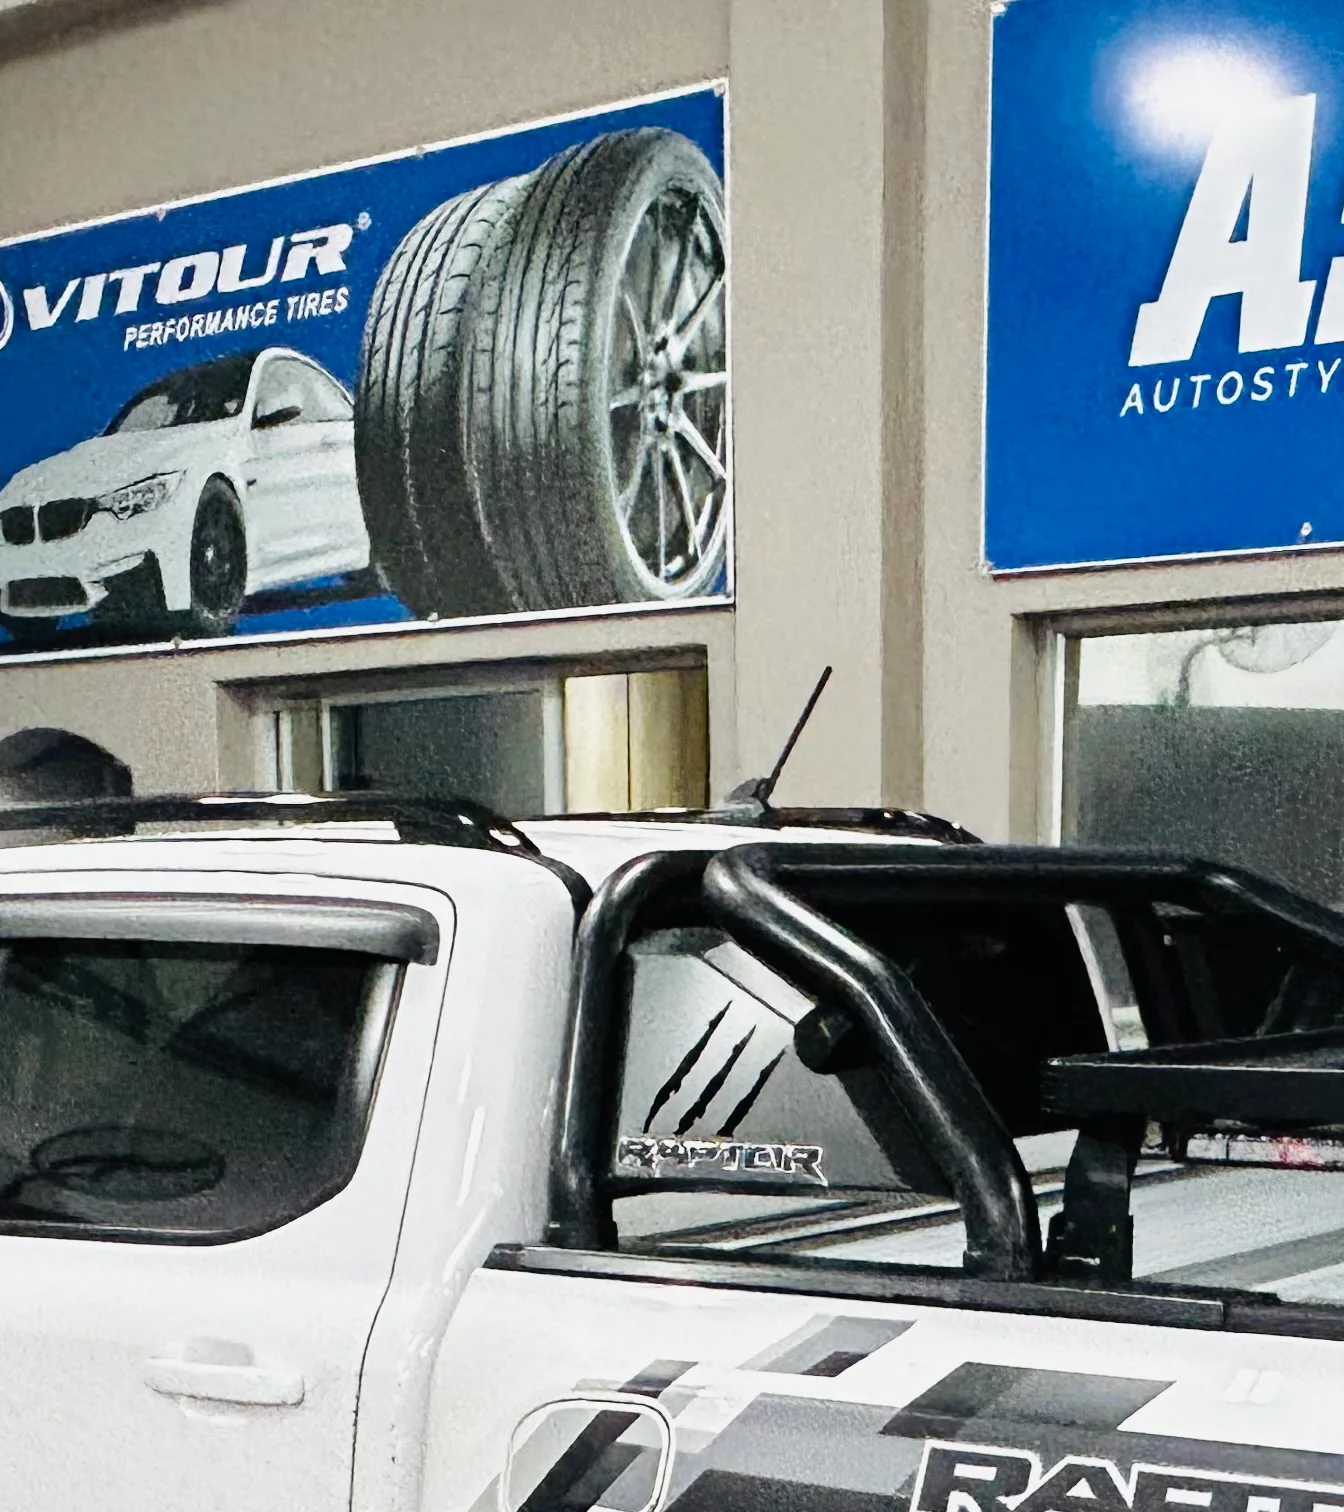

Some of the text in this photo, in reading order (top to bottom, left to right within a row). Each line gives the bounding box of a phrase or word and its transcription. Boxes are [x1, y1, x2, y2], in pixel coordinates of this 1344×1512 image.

[22, 222, 354, 332] VITOUR
[123, 285, 350, 352] PERFORMANCE TIRES
[616, 1135, 829, 1188] RAPTOR
